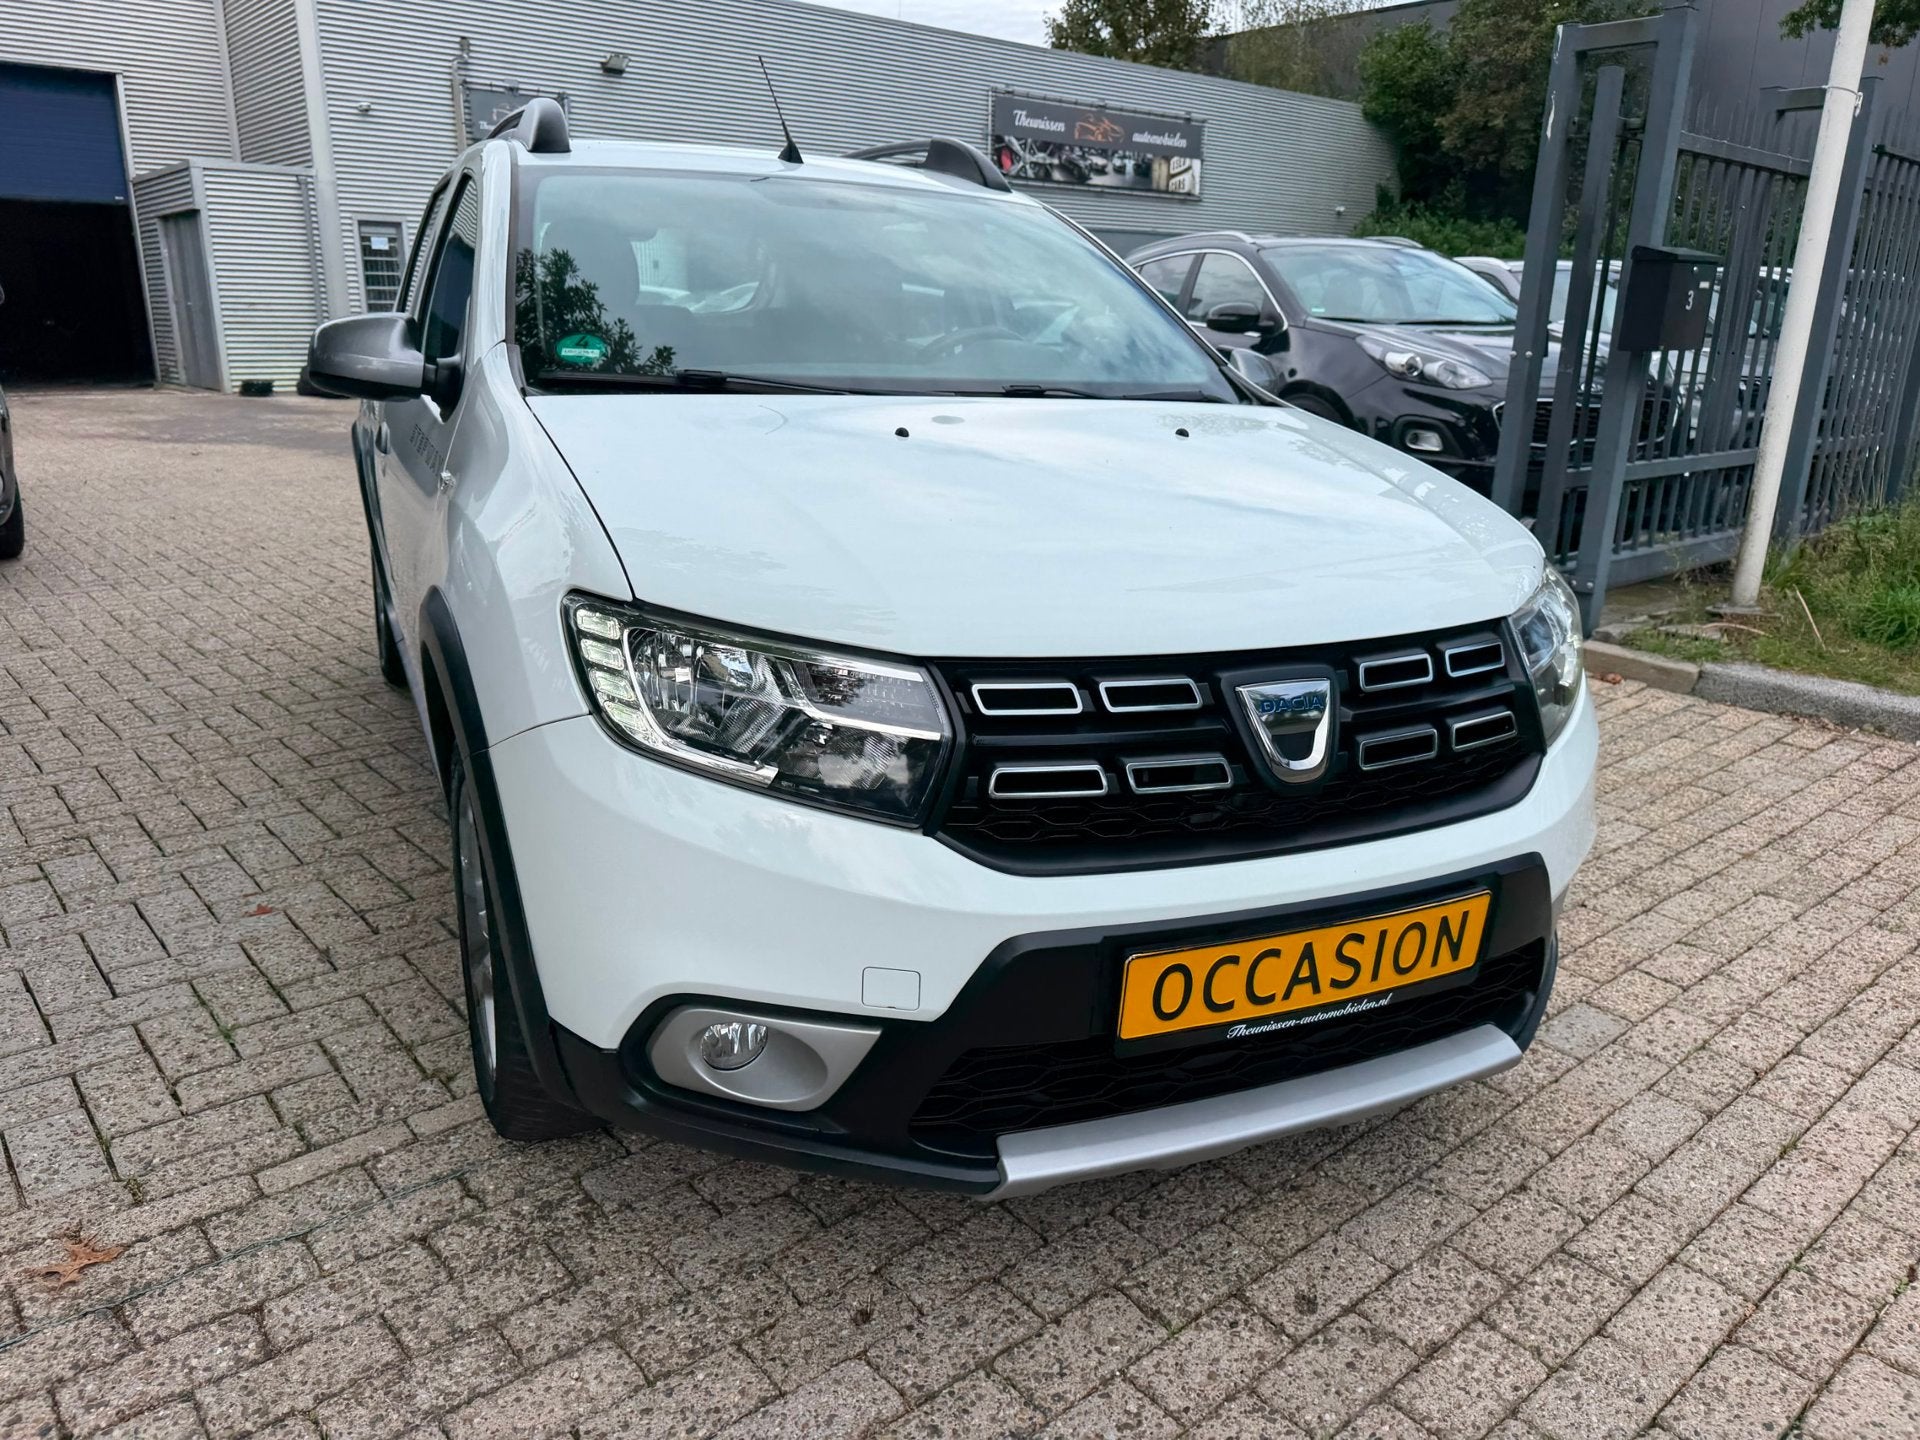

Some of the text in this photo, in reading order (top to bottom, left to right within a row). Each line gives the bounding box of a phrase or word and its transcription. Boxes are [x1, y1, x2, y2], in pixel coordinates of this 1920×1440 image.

[1013, 110, 1065, 132] Theunissen
[1685, 290, 1694, 310] 3
[575, 335, 588, 349] 4
[1260, 695, 1324, 714] DACIA
[1152, 911, 1469, 1021] OCCASION
[1227, 993, 1393, 1039] Theunissen-automobielen.nl
